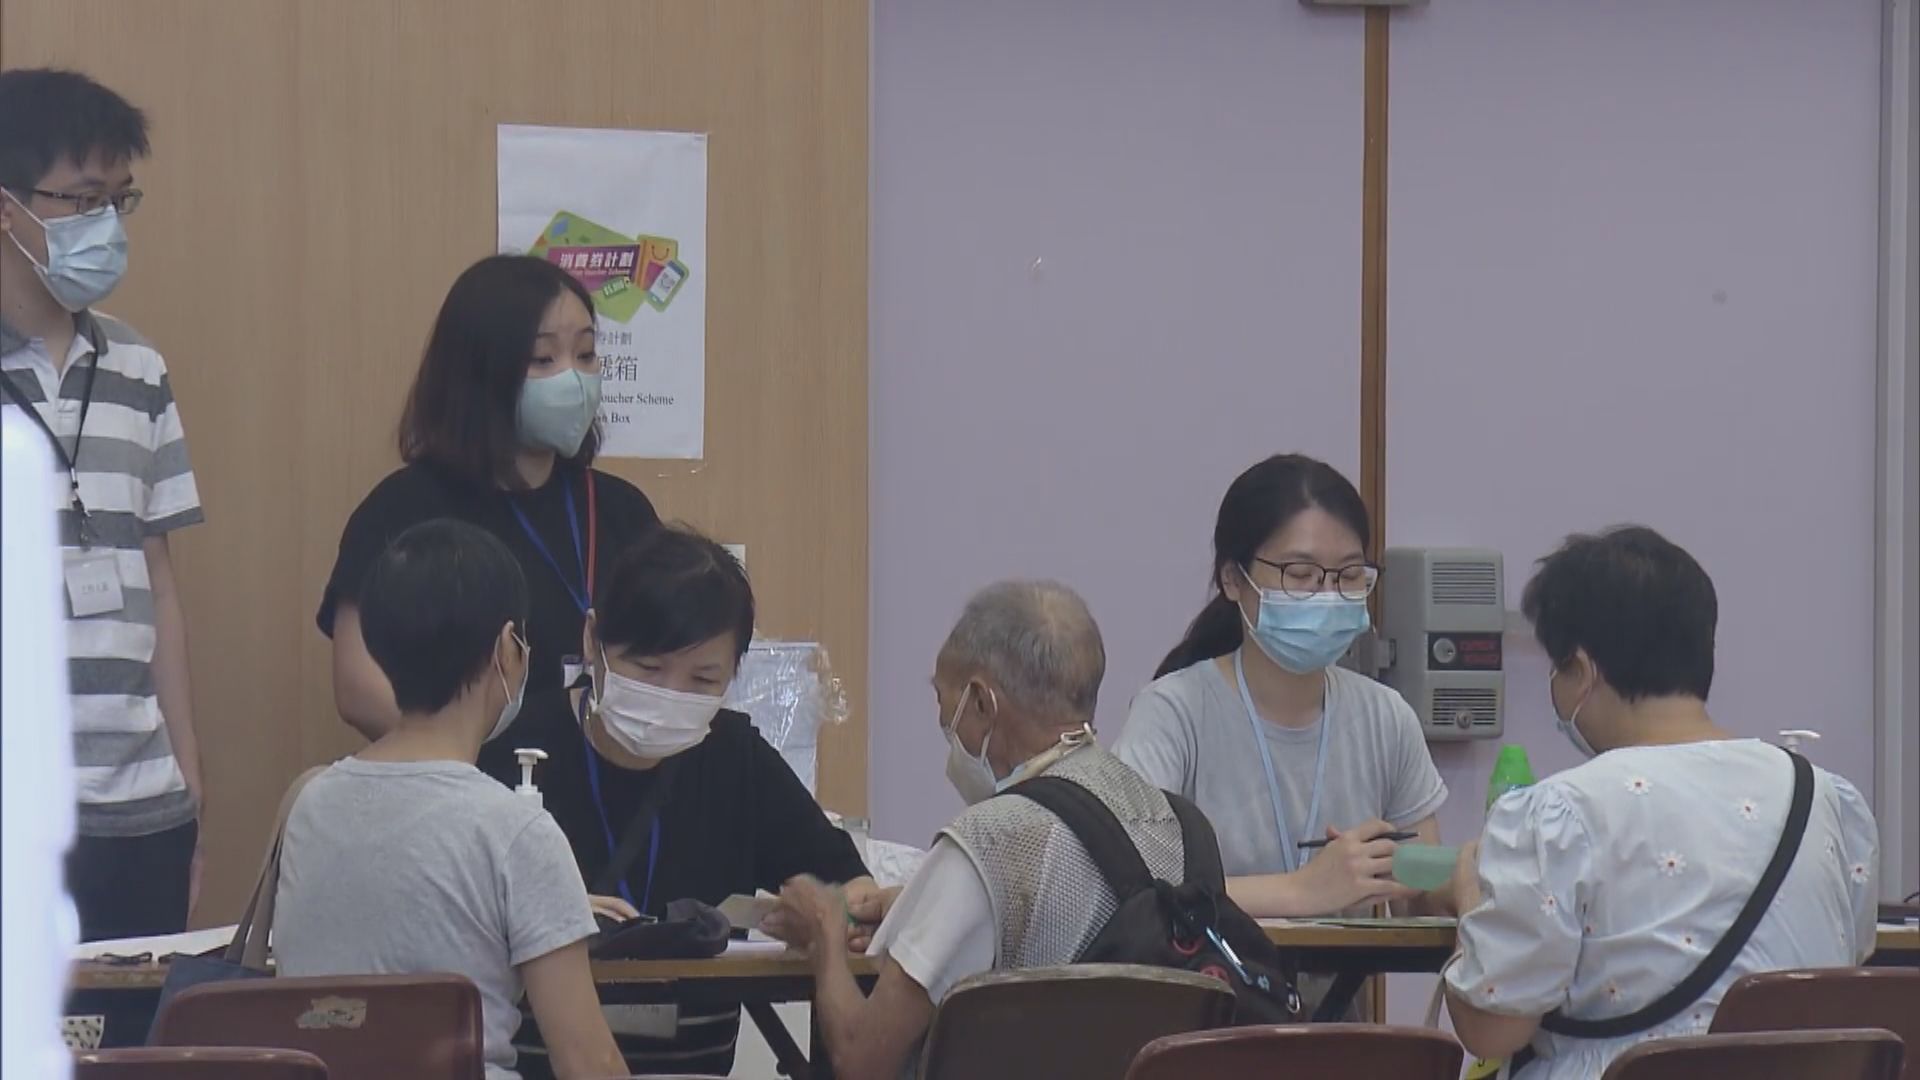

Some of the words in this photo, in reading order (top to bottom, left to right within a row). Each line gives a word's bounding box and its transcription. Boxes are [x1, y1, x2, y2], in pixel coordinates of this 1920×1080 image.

[559, 251, 634, 269] 消費券計劃
[596, 331, 632, 345] 券計劃
[598, 353, 638, 381] 遞箱
[600, 393, 634, 405] oucher
[636, 393, 675, 406] Scheme
[611, 412, 631, 424] Box
